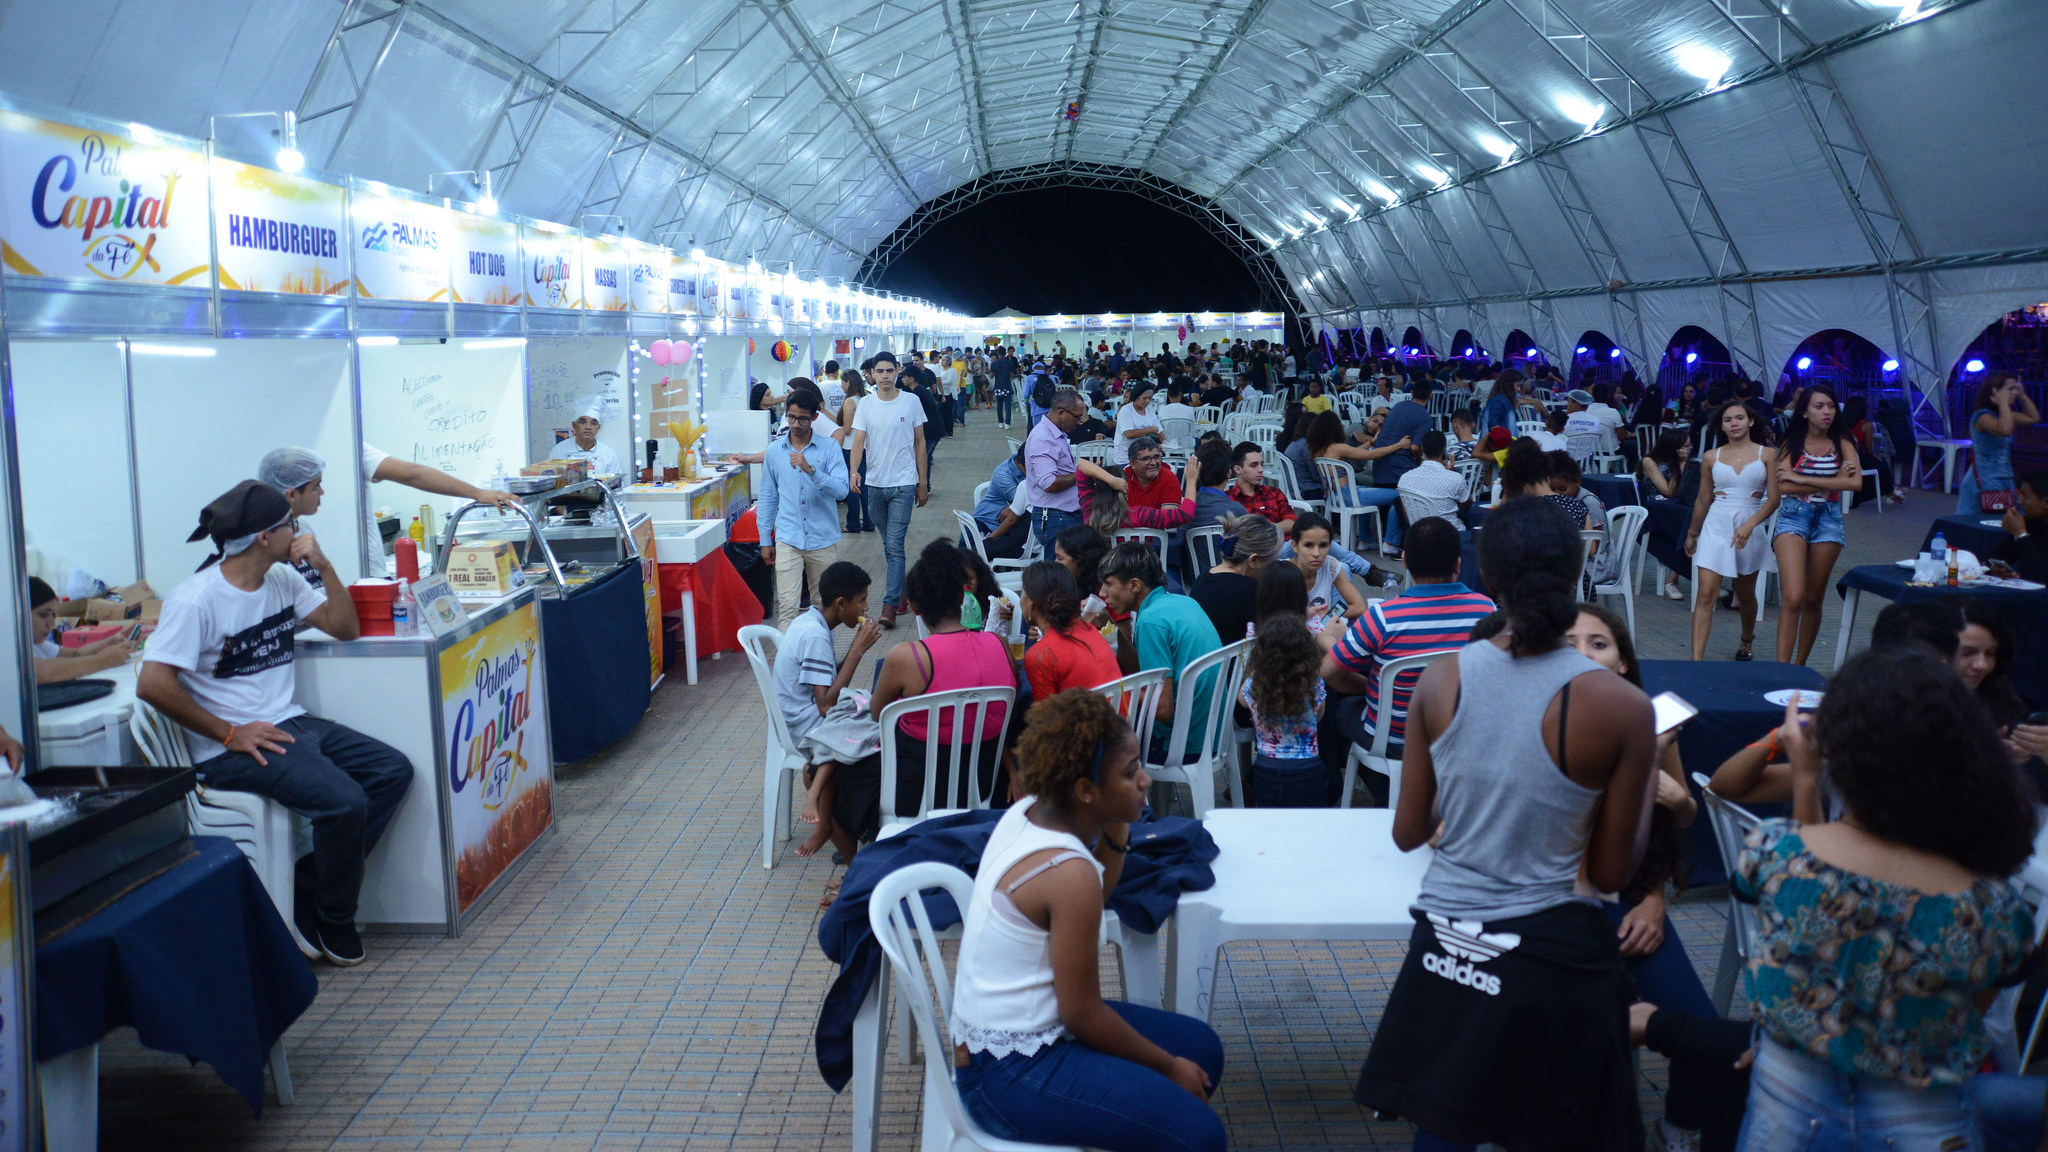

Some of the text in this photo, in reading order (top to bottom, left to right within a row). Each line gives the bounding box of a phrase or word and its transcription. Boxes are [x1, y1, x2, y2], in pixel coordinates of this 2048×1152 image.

[31, 154, 180, 242] Capital
[92, 244, 105, 262] da
[229, 213, 338, 260] HAMBURGUER
[392, 221, 438, 250] PALMAS
[469, 250, 487, 276] HOT
[488, 251, 506, 278] DOG
[534, 251, 572, 289] Capital
[594, 266, 618, 289] MASSAS
[453, 574, 471, 583] REAL
[475, 648, 520, 707] Palmas
[450, 638, 536, 793] Capital
[1422, 951, 1501, 996] adidas
